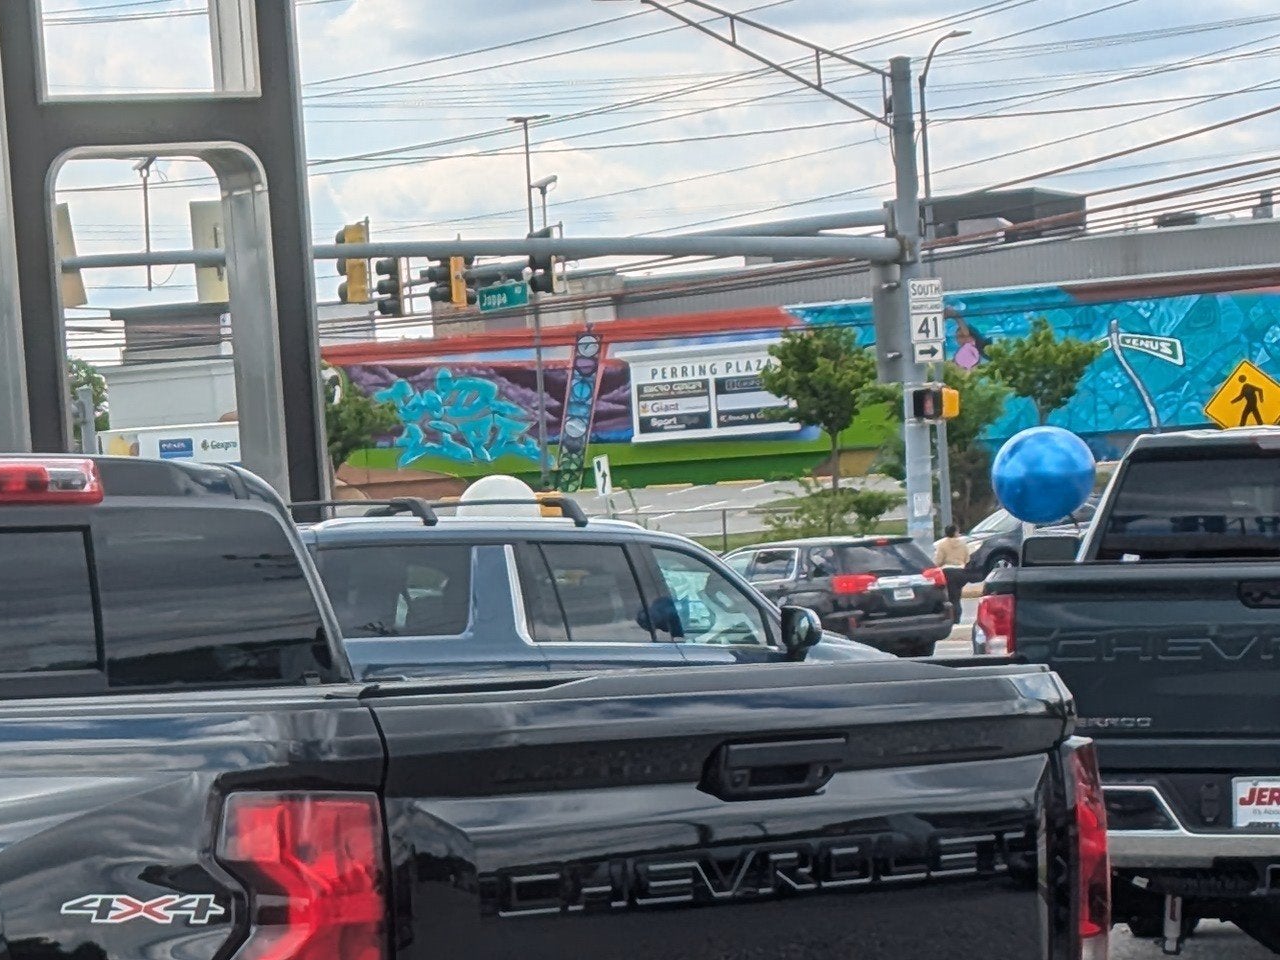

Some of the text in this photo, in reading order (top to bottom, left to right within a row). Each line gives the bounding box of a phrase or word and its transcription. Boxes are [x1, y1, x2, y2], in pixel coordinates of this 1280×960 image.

[911, 283, 940, 296] SOUTH
[918, 316, 938, 338] 41
[651, 358, 773, 380] PERRING PLAZA
[651, 402, 679, 413] Giant
